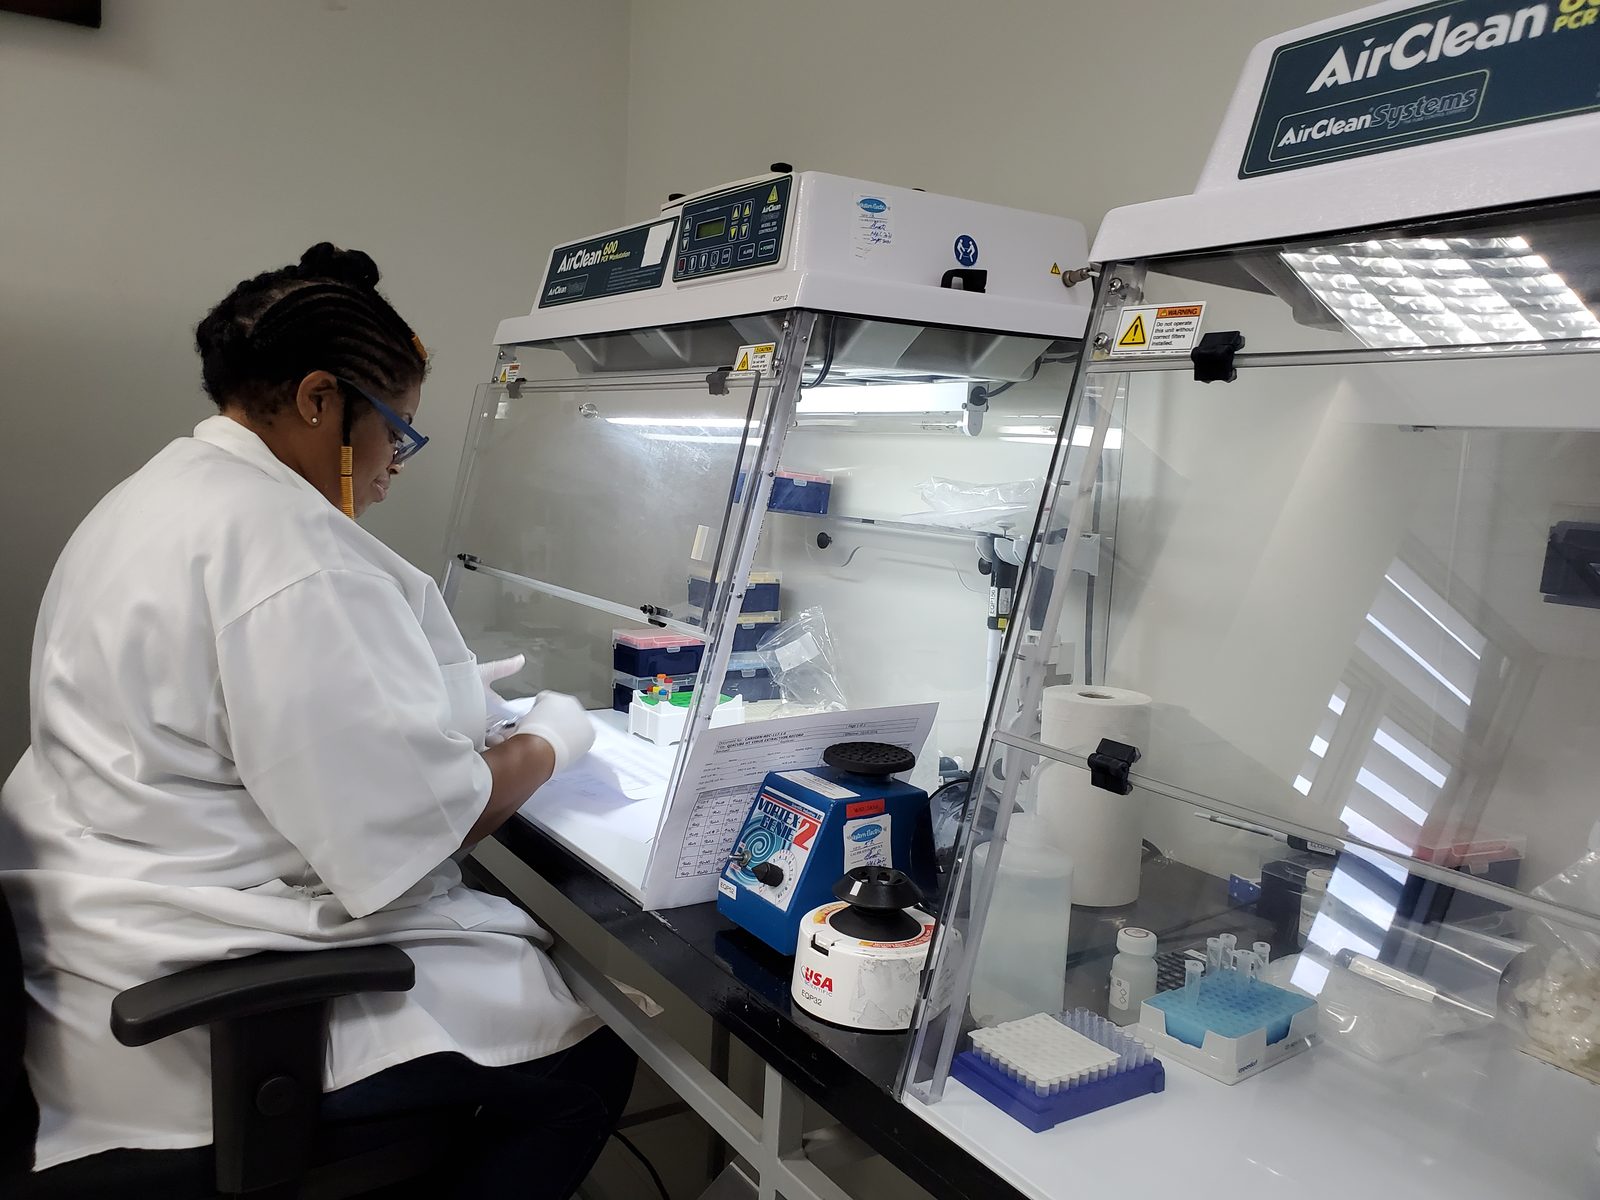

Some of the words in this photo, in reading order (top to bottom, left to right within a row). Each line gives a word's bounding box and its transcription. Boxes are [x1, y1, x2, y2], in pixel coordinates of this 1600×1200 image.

[1552, 8, 1599, 33] PCR
[1306, 3, 1549, 94] AirClean
[557, 248, 602, 273] AirClean
[603, 240, 619, 256] 600
[548, 286, 567, 297] AirClean
[1167, 308, 1198, 316] WARNING
[760, 814, 796, 841] GENIE
[792, 818, 818, 851] 2
[805, 966, 833, 992] USA
[801, 989, 823, 1007] EQP32
